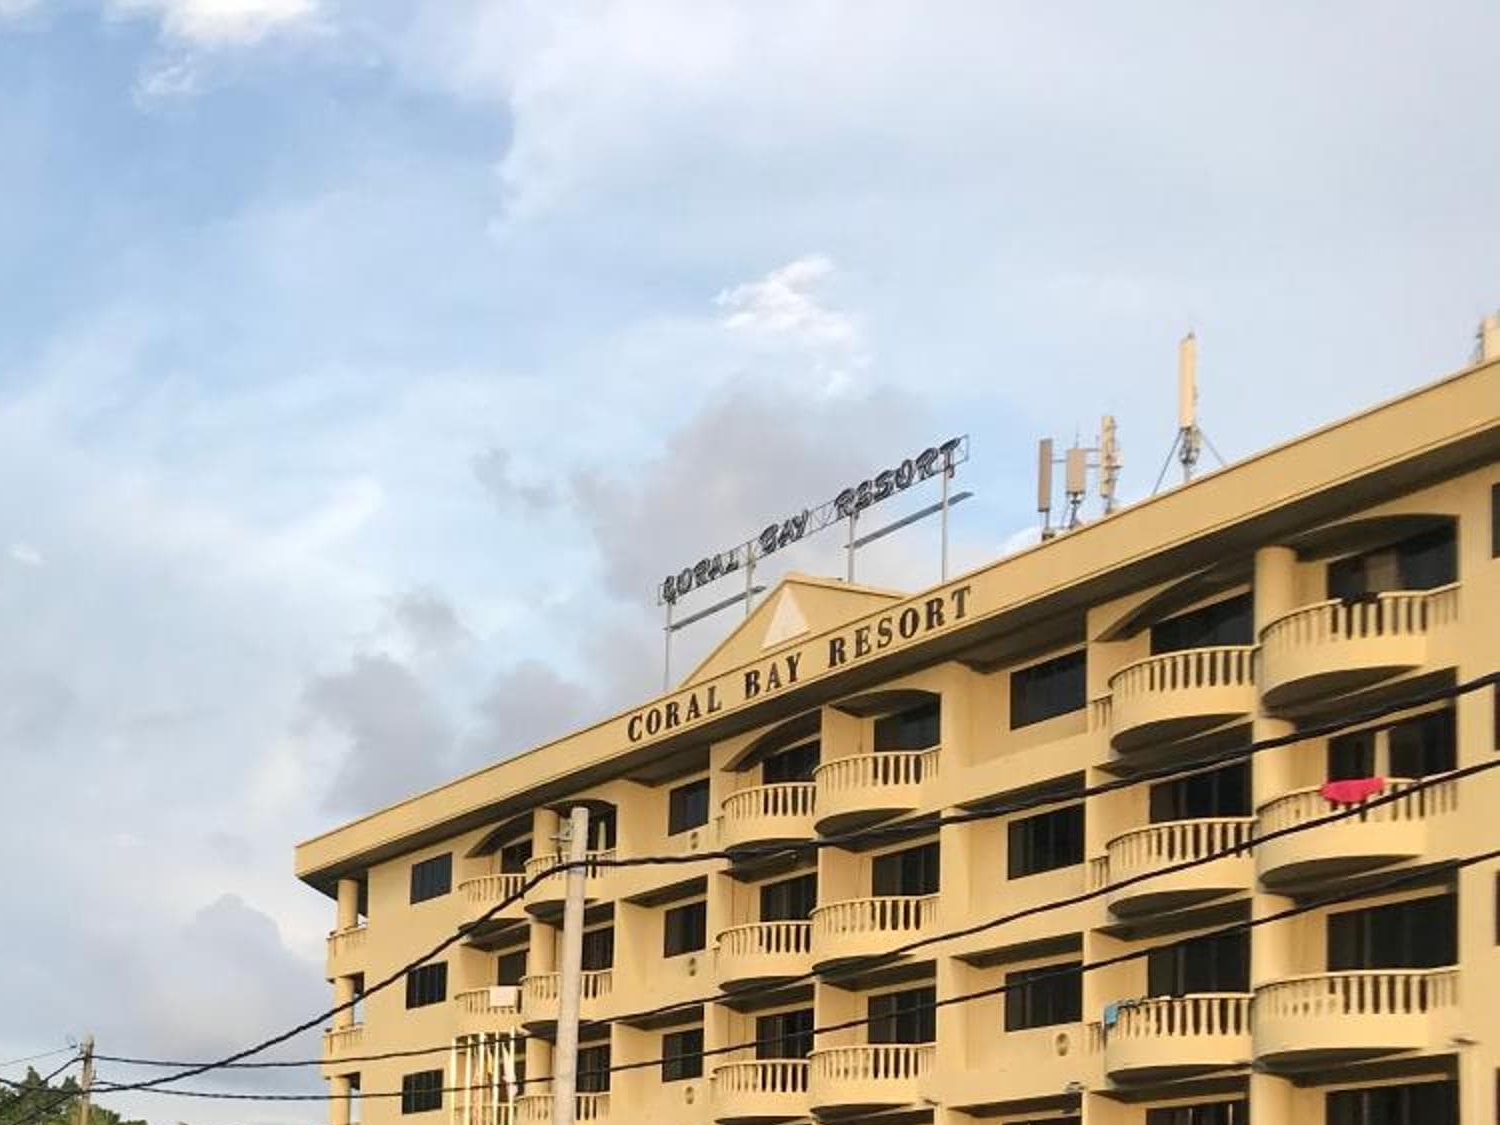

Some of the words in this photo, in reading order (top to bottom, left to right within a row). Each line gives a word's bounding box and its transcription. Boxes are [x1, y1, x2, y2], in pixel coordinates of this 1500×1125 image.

[662, 551, 740, 604] CORAL
[759, 510, 809, 554] BAY
[834, 438, 961, 519] RESORT
[627, 686, 722, 742] CORAL
[745, 653, 801, 698] BAY
[828, 586, 972, 667] RESORT
